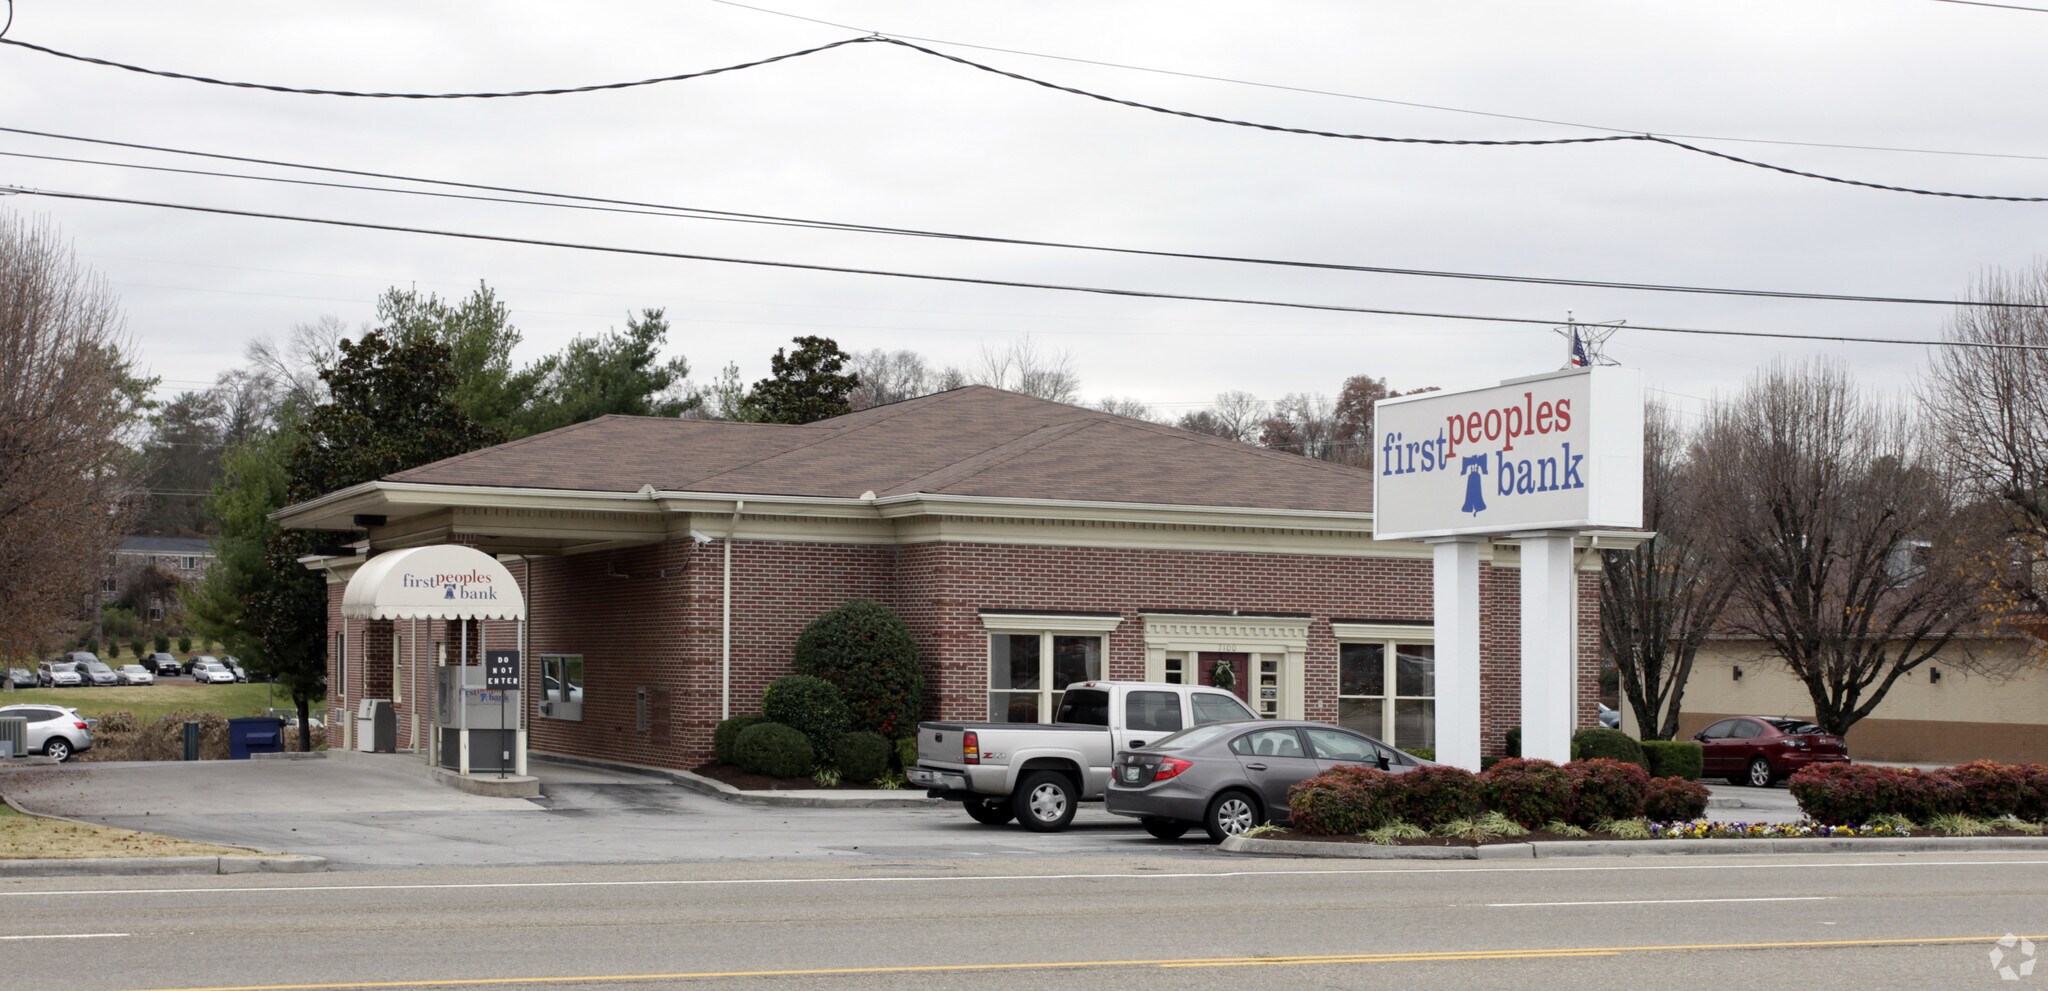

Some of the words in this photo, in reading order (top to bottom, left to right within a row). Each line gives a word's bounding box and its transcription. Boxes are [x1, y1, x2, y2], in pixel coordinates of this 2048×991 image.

[1382, 427, 1447, 476] first
[1445, 392, 1571, 458] peoples
[1496, 442, 1584, 496] bank
[403, 573, 436, 588] first
[436, 569, 492, 586] peoples
[460, 585, 498, 600] bank
[497, 656, 509, 664] DO
[487, 677, 518, 685] ENTER
